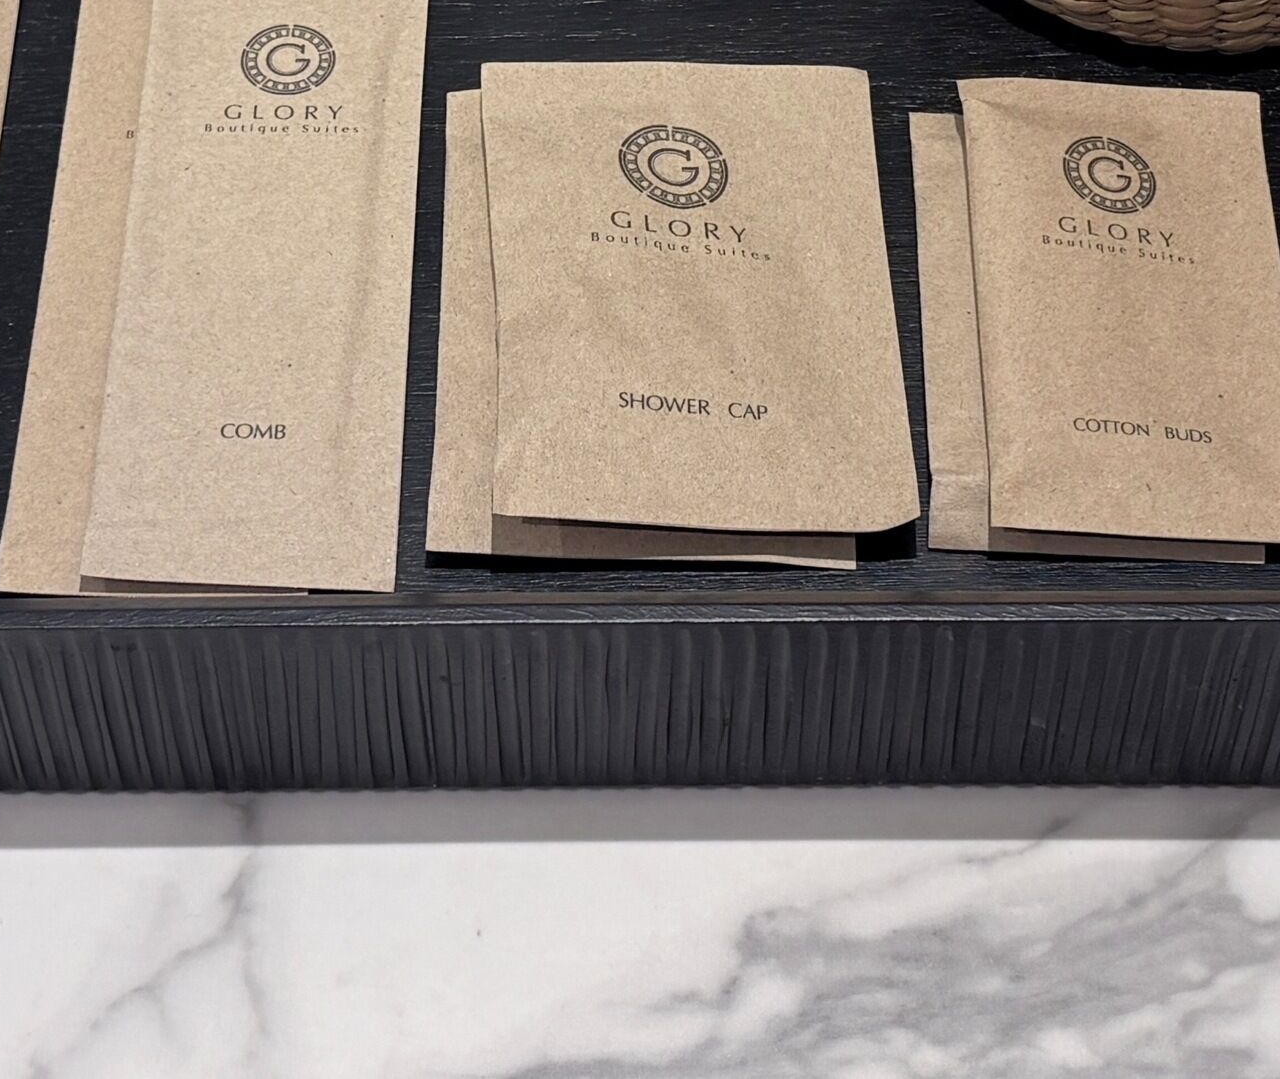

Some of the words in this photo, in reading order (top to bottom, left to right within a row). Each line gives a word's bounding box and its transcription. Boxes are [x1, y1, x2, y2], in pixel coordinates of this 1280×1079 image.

[223, 104, 344, 121] GLORY
[204, 123, 290, 135] Boutique
[301, 123, 360, 134] Suites
[610, 210, 747, 243] GLORY
[1058, 216, 1175, 248] GLORY
[590, 231, 690, 253] Boutique
[704, 244, 772, 262] Suites
[1042, 234, 1128, 256] Boutique
[1138, 247, 1196, 265] Suites
[618, 392, 711, 416] SHOWER
[728, 402, 768, 420] CAP
[220, 423, 286, 440] COMB
[1073, 417, 1150, 437] COTTON
[1164, 426, 1212, 444] BUDS
